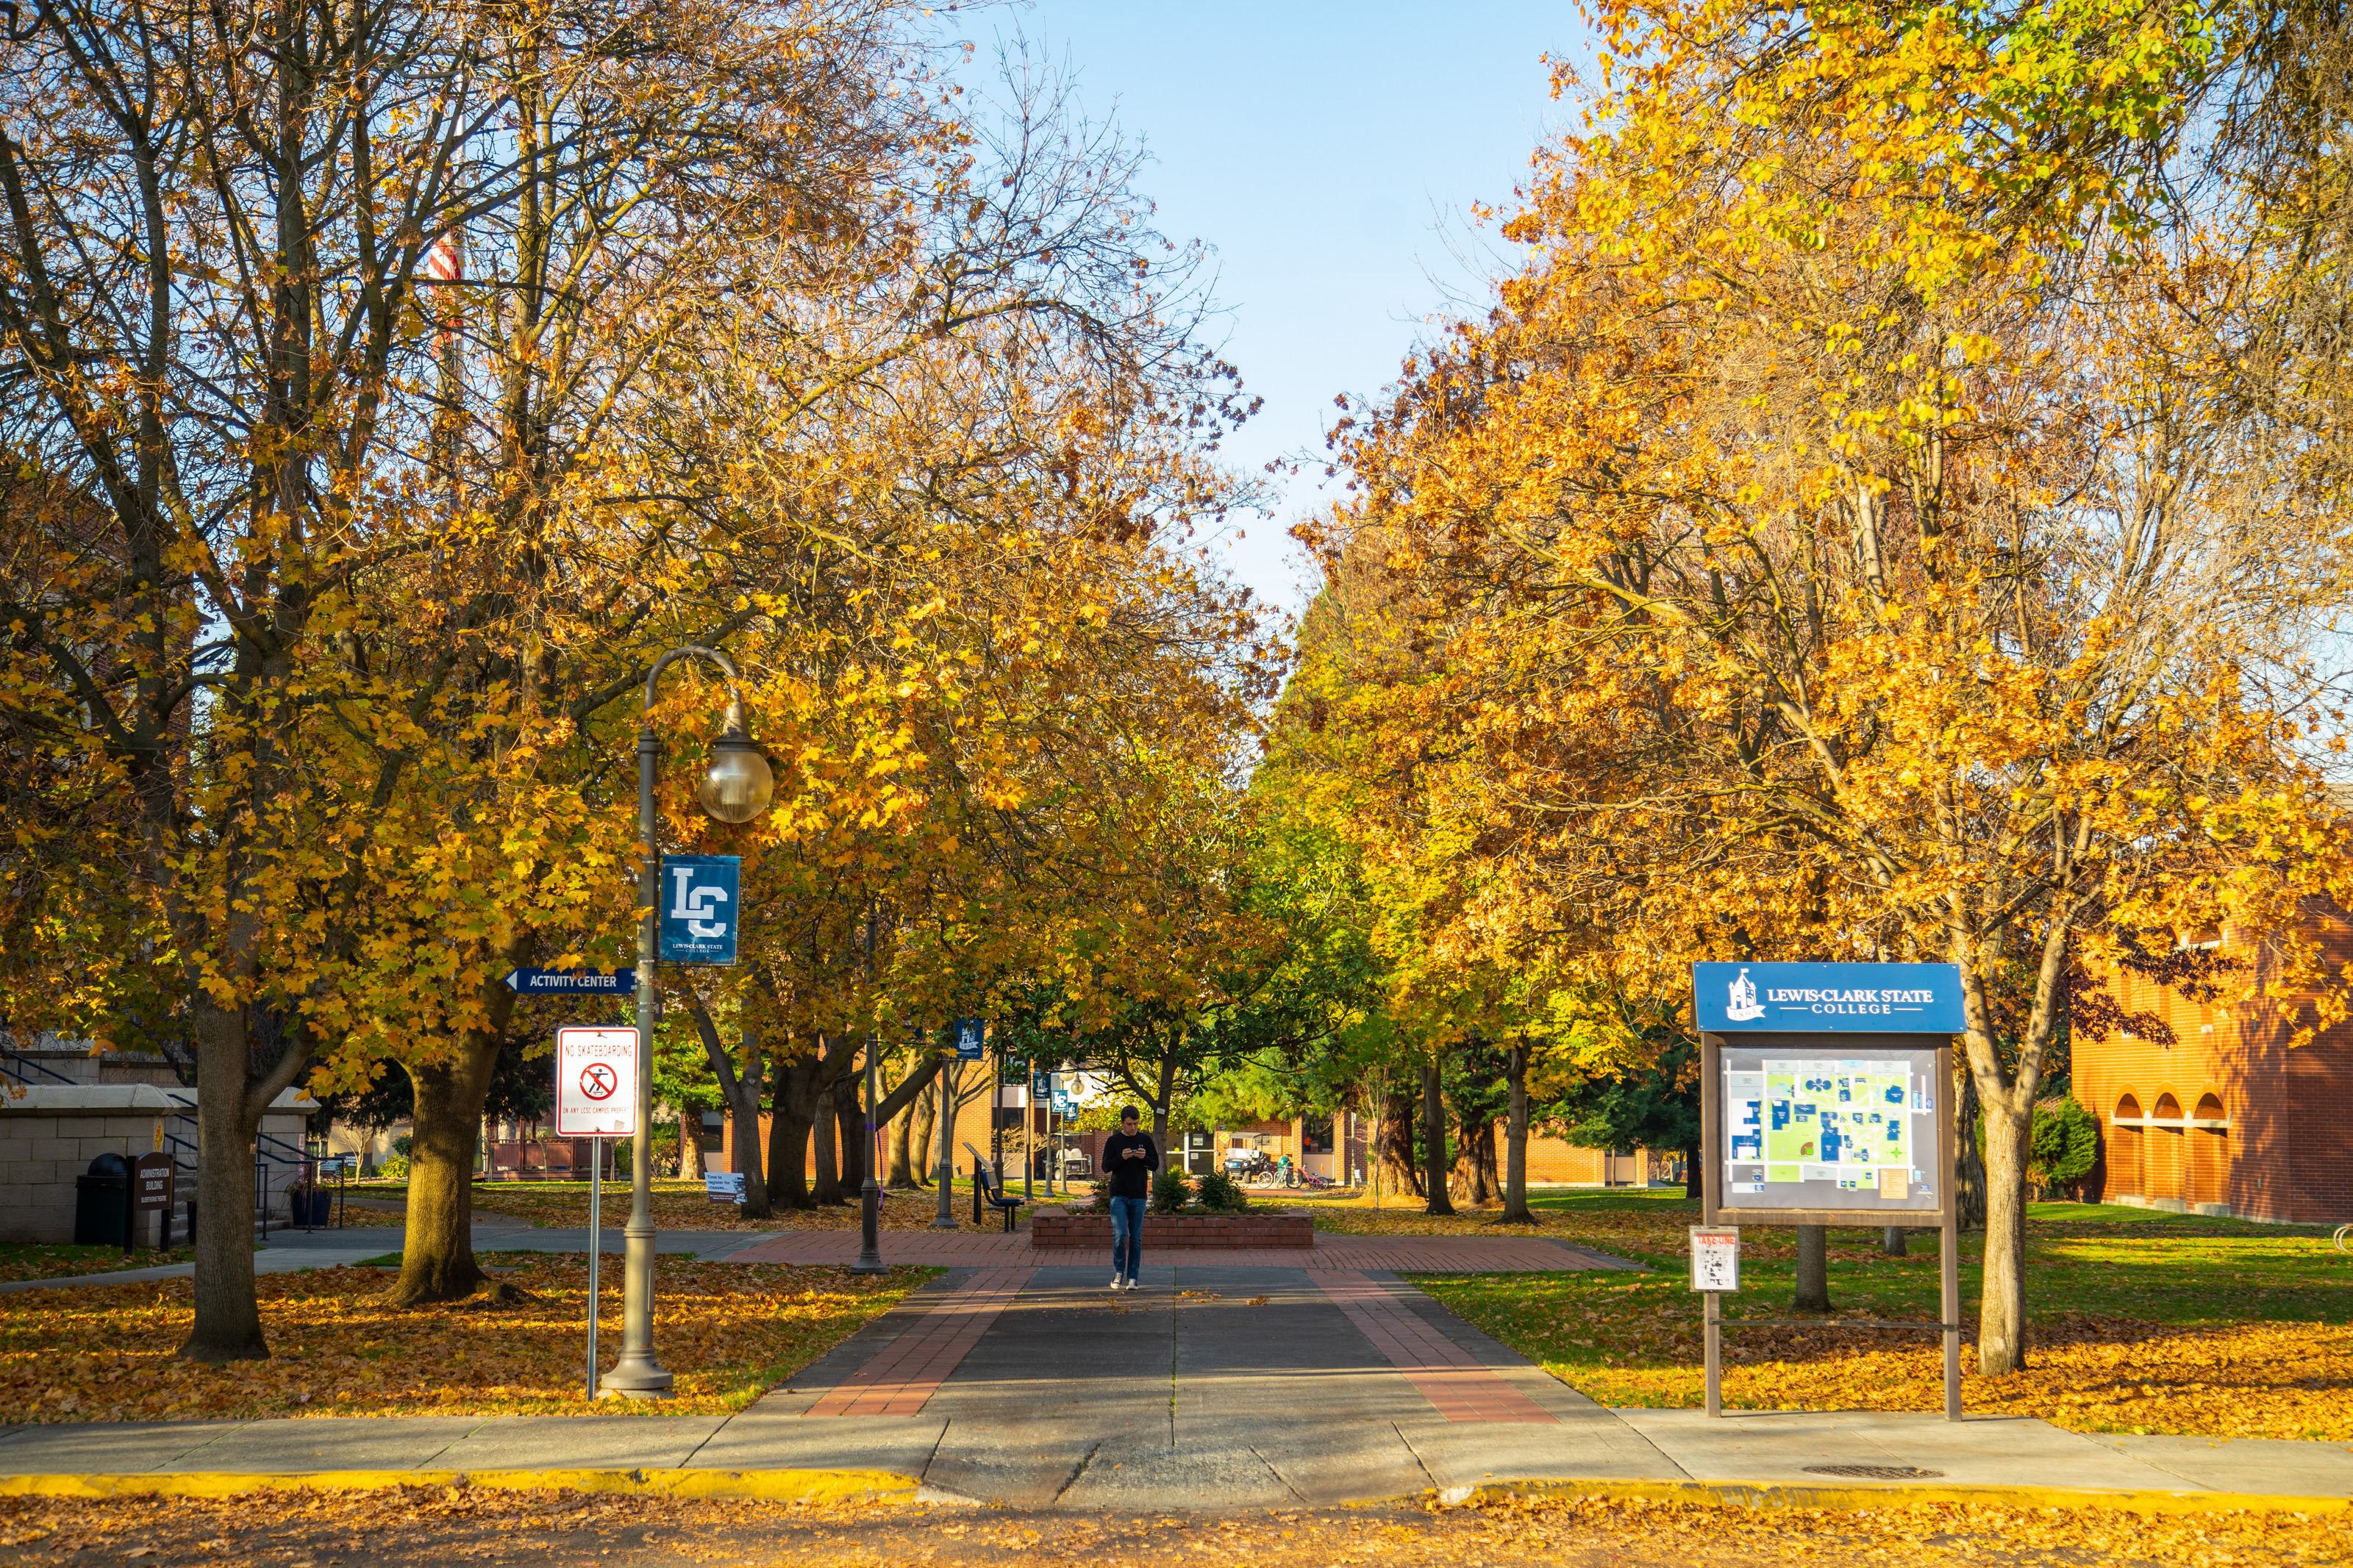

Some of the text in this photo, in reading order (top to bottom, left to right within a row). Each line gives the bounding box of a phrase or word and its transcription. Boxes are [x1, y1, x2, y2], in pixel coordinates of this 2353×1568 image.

[671, 867, 728, 937] LC
[529, 975, 617, 987] ACTIVITY CENTER
[1766, 988, 1935, 1003] LEWIS-CLARK STATE
[1811, 1003, 1892, 1014] COLLEGE
[565, 1045, 632, 1057] NO SKATEBOARDING
[146, 1180, 163, 1190] BUILDING
[1696, 1234, 1735, 1245] TAKE ONE
